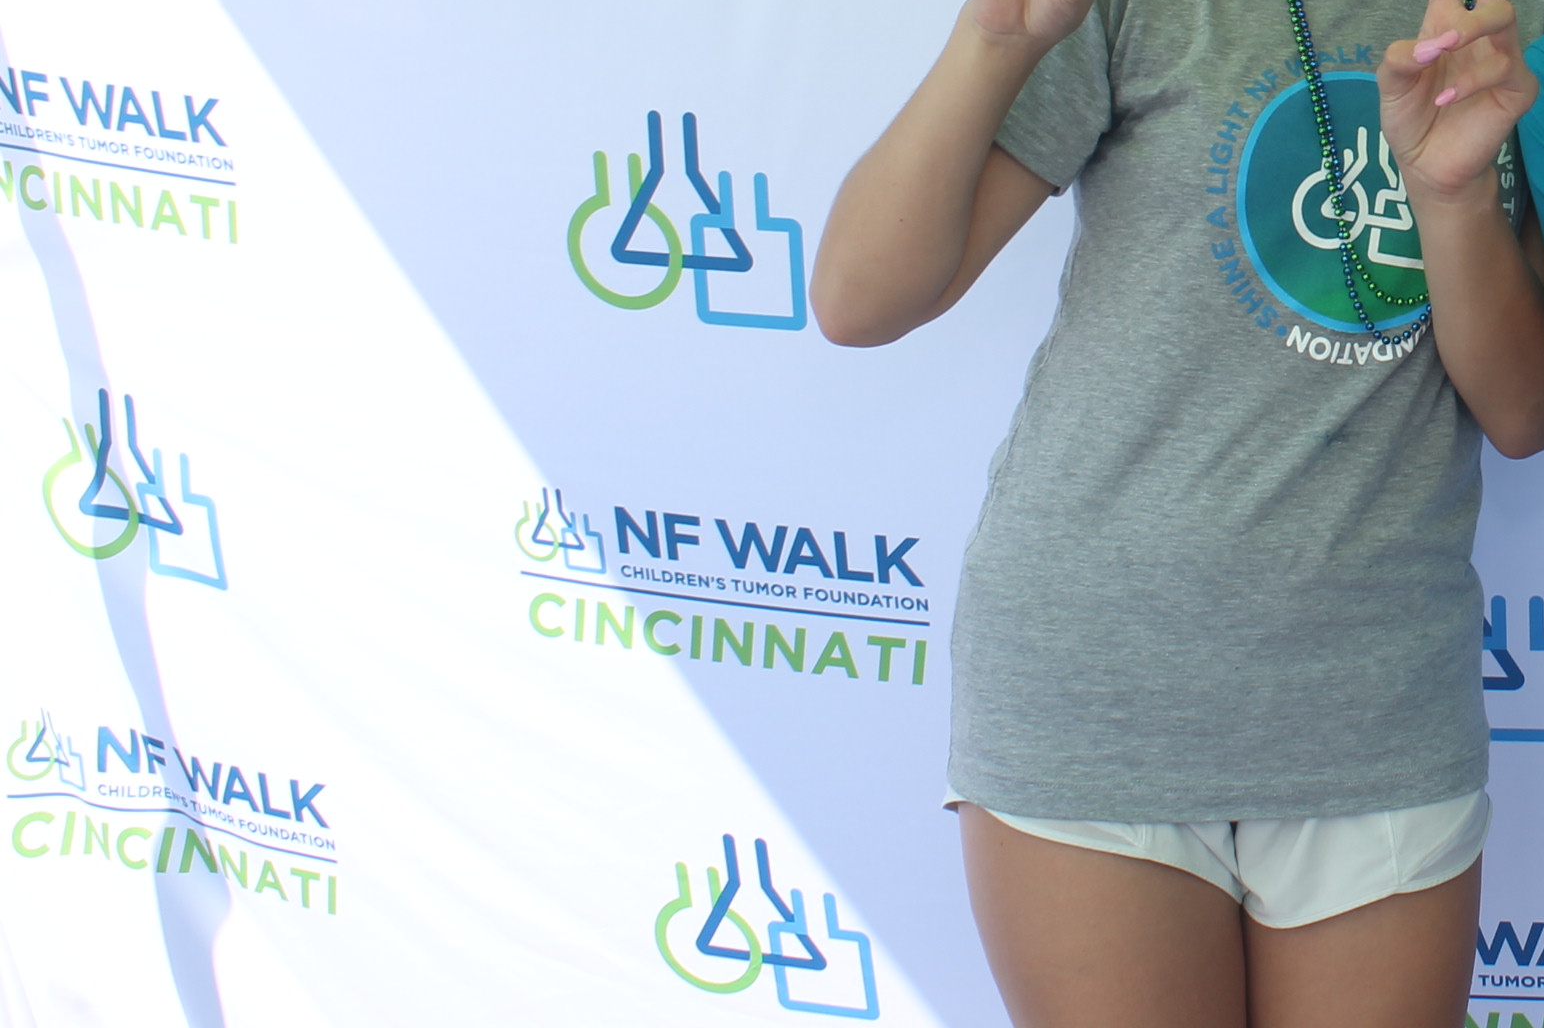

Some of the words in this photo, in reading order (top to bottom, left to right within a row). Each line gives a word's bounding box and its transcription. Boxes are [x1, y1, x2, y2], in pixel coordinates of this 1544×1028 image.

[59, 76, 228, 148] WALK
[1244, 69, 1278, 100] NF
[78, 136, 130, 156] TUMOR
[134, 145, 234, 172] FOUNDATION
[1206, 100, 1249, 194] LIGHT
[1206, 205, 1229, 228] A
[1210, 238, 1279, 328] SHINE
[613, 505, 700, 561] NF
[714, 517, 925, 587] WALK
[620, 564, 726, 591] CHILDREN'S
[731, 579, 797, 599] TUMOR
[803, 587, 930, 612] FOUNDATION
[528, 592, 927, 686] CINCINNATI
[97, 726, 166, 774] NF
[172, 746, 330, 829] WALK
[12, 811, 337, 915] CINCINNATI
[238, 818, 336, 851] FOUNDATION
